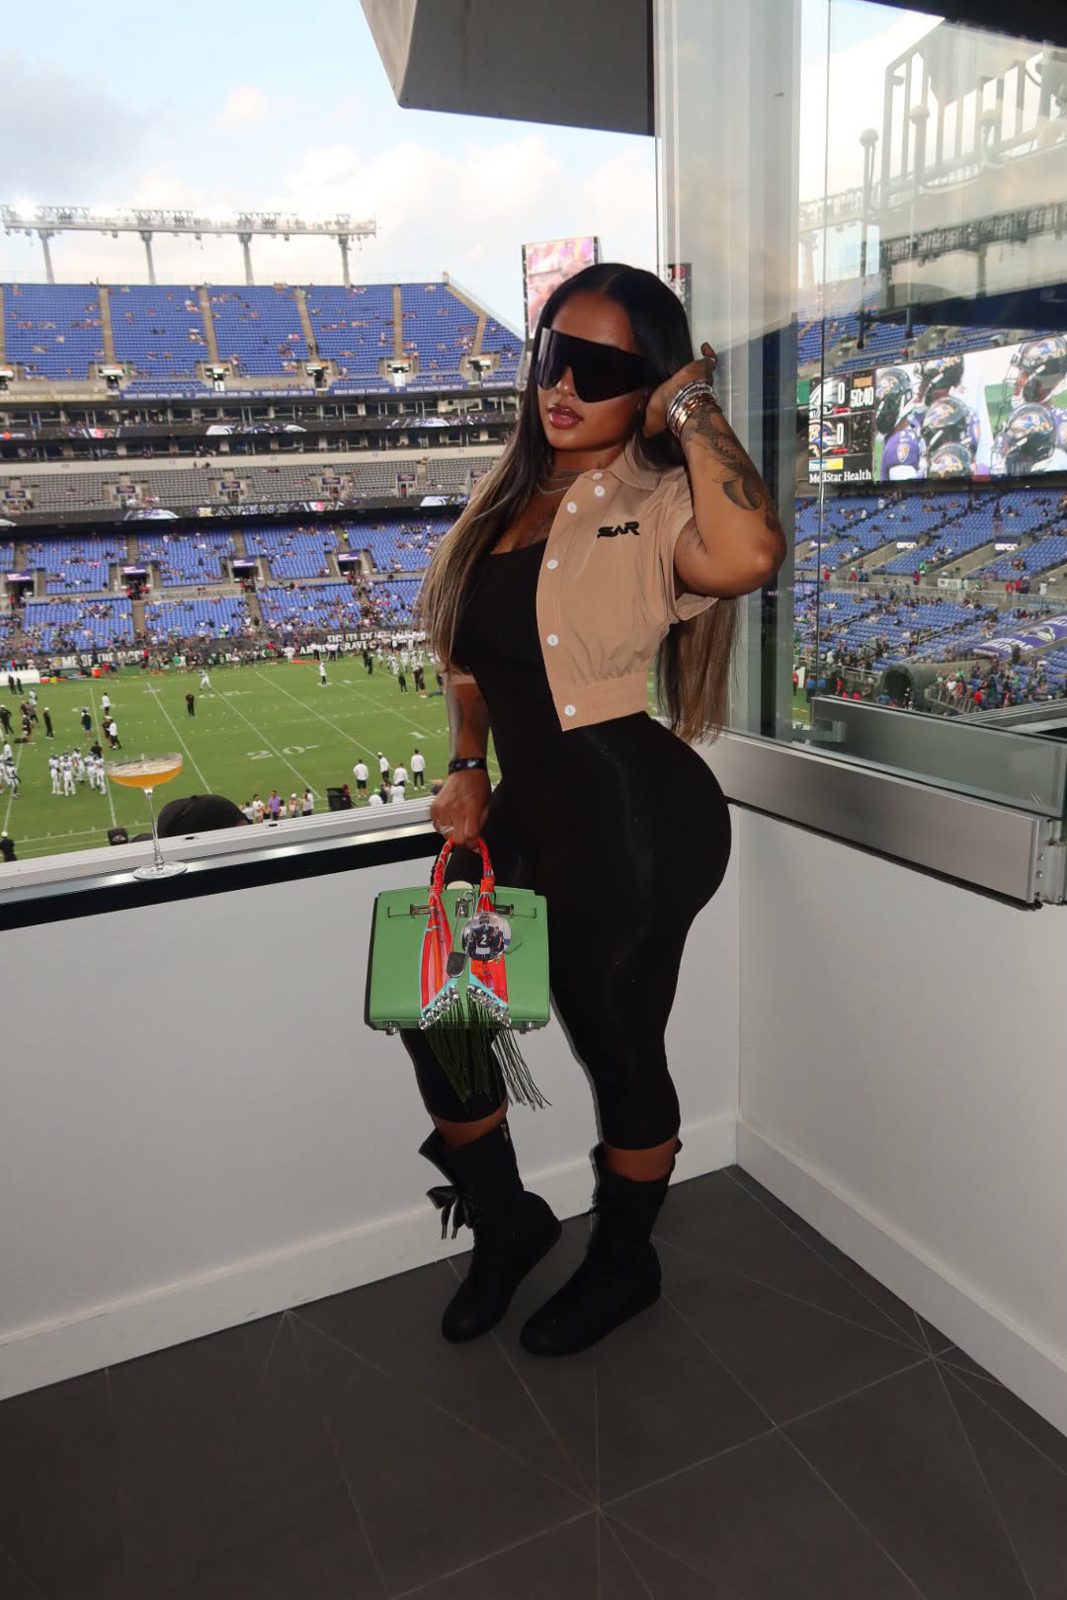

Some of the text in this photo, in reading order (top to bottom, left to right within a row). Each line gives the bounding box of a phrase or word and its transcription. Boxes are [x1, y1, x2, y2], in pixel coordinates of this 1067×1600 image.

[837, 382, 846, 404] 0
[836, 423, 845, 444] 0
[809, 469, 872, 484] MedStar Health
